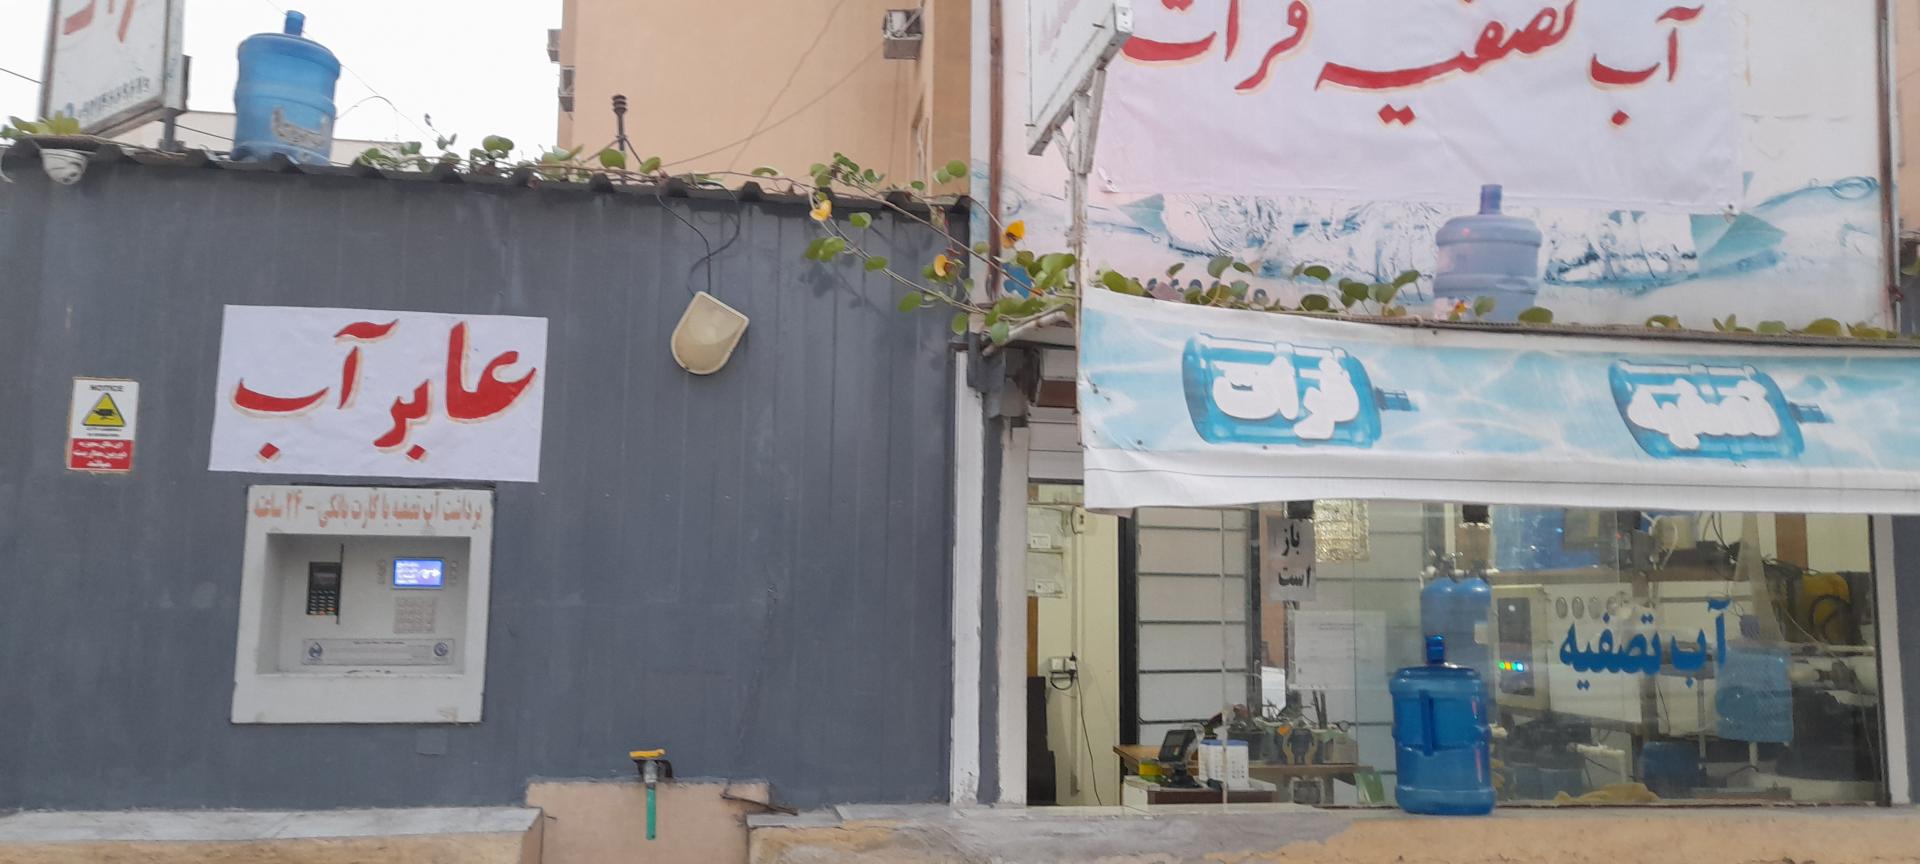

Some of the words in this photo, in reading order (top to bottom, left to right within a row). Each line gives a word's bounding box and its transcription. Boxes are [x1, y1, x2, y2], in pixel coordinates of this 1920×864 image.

[1590, 6, 1703, 126] آب
[90, 384, 124, 392] NOTICE
[234, 319, 399, 461] آب
[374, 321, 537, 461] عابر
[1278, 565, 1311, 589] است
[1281, 523, 1300, 557] باز
[1559, 611, 1662, 691] تصفیه
[1670, 597, 1731, 688] آب
